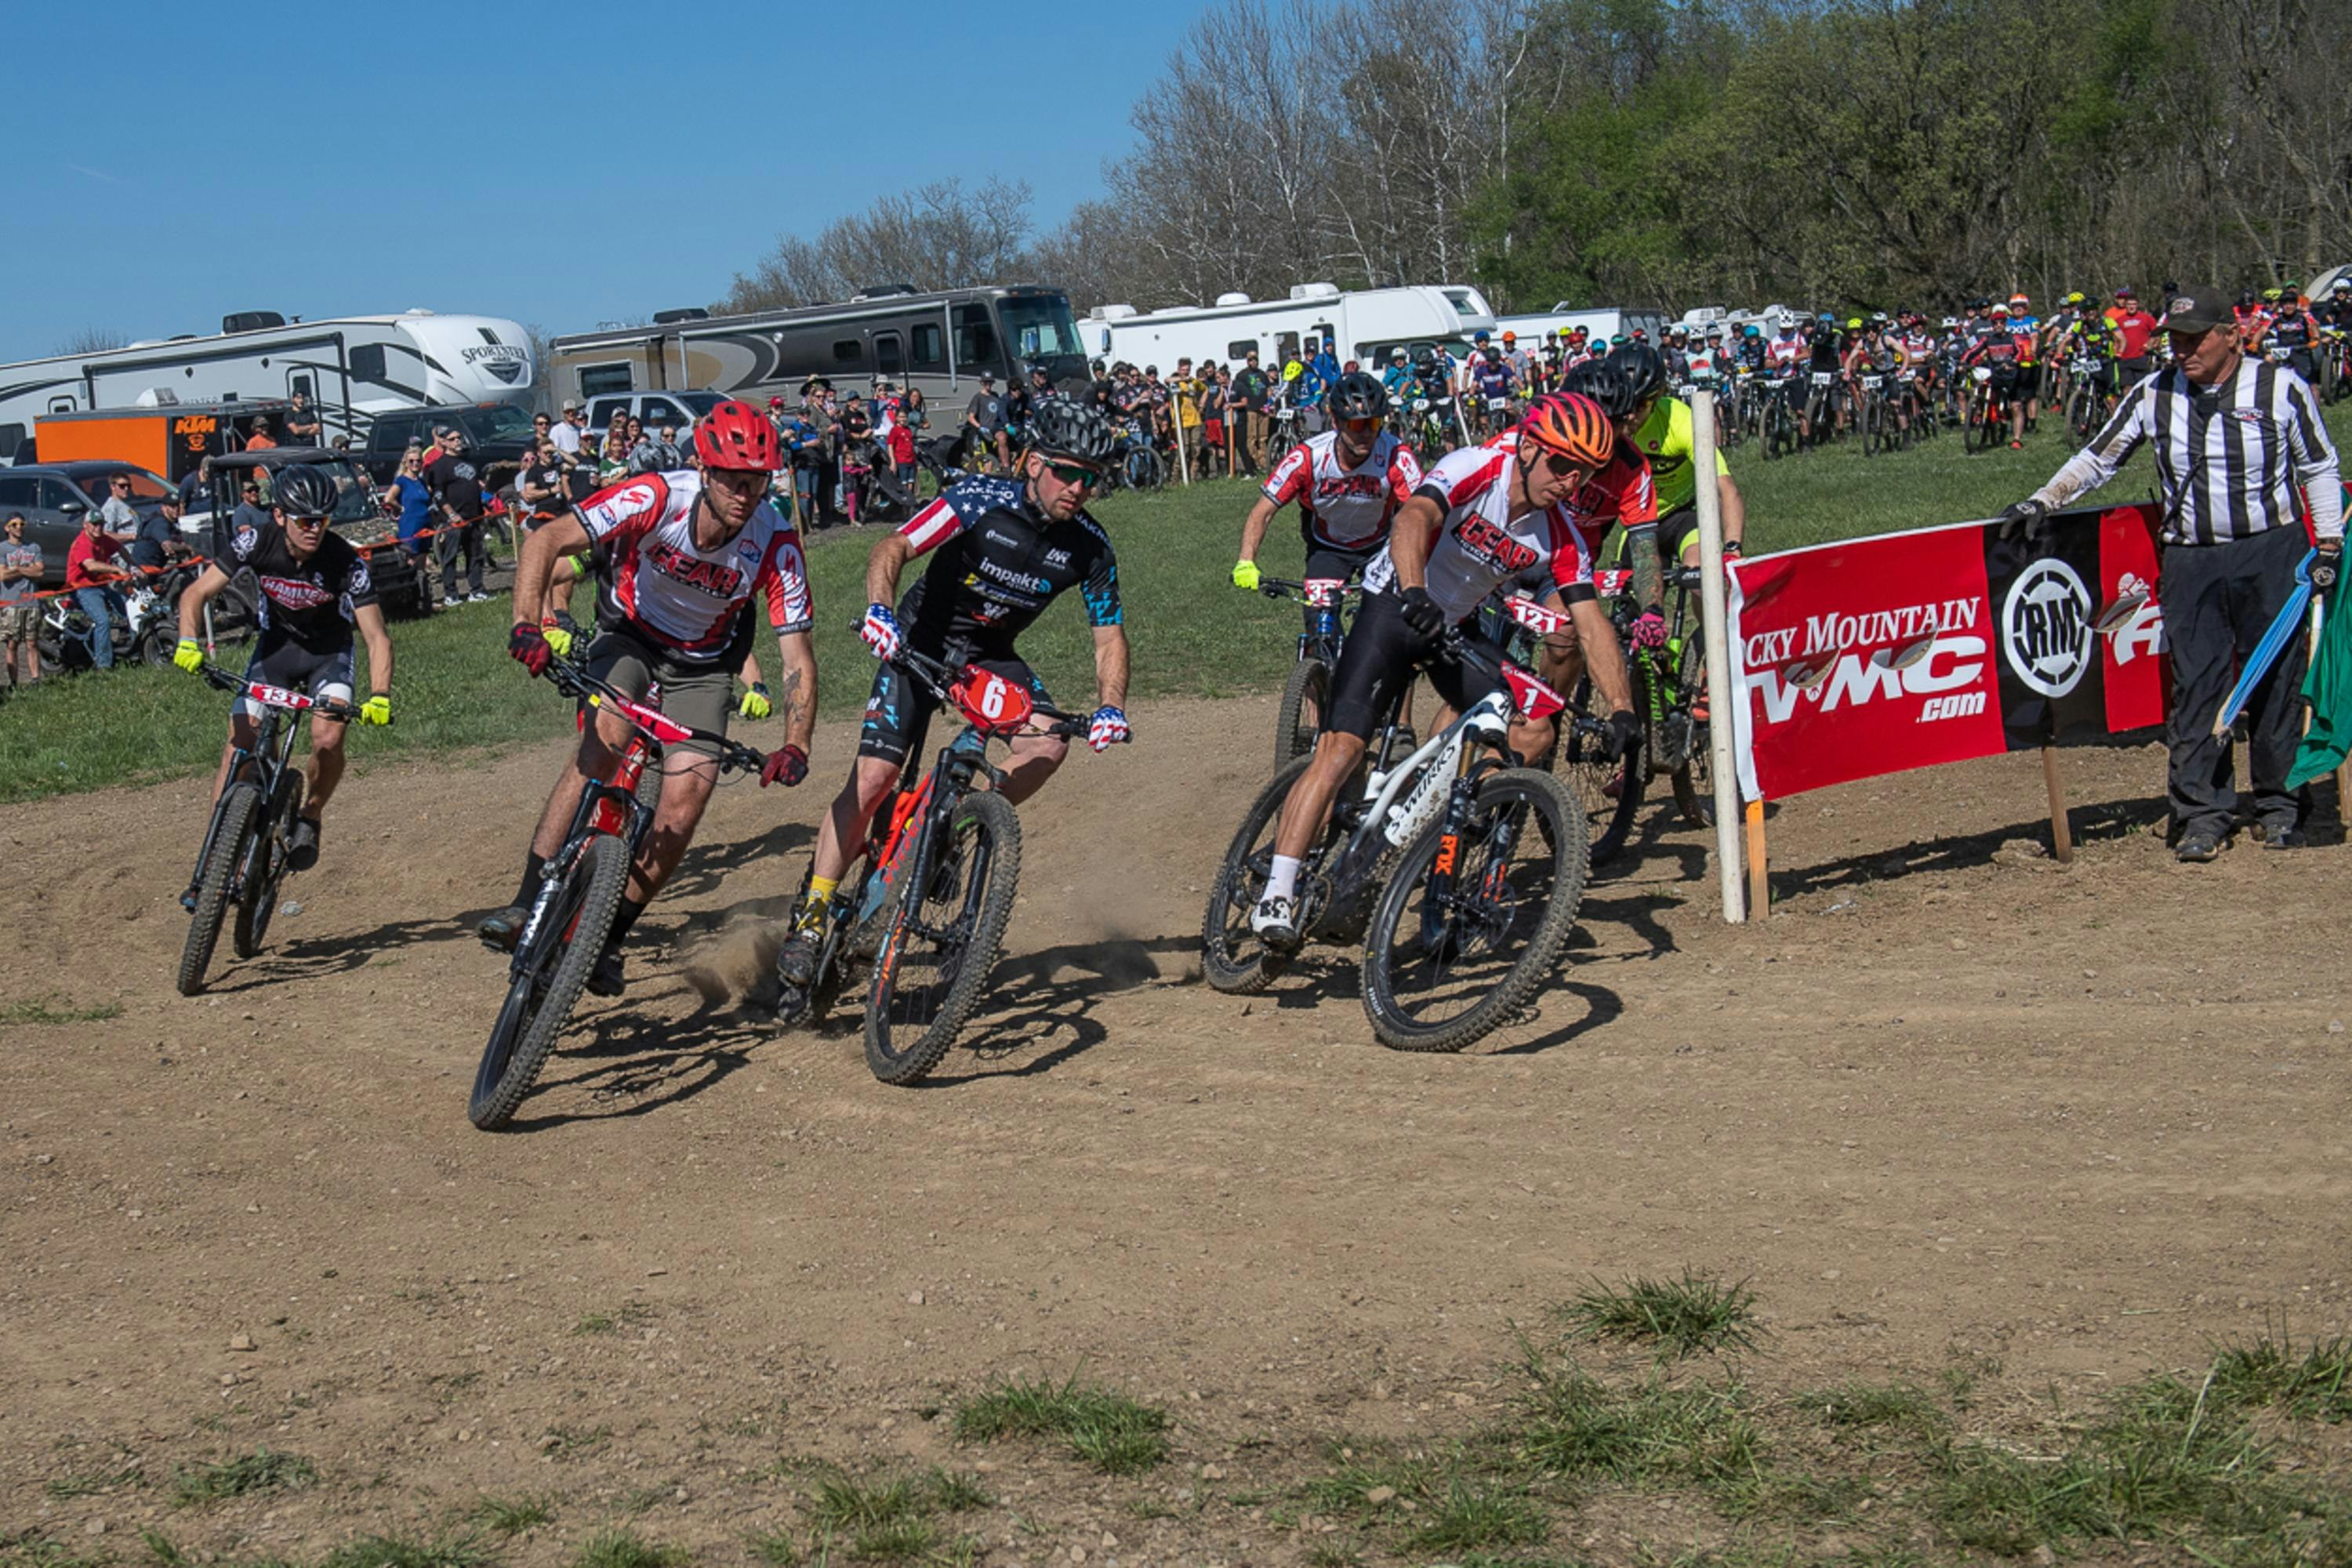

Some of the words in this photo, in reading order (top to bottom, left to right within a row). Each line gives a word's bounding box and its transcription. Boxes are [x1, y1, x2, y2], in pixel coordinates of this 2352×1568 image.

[175, 415, 216, 434] KTM
[1460, 513, 1537, 569] GEAR
[646, 541, 741, 594] GEAR
[979, 556, 1040, 590] impakt
[1514, 605, 1556, 634] 121
[1740, 626, 1798, 667] CKY
[1802, 597, 1982, 656] MOUNTAIN
[982, 680, 1007, 719] 6
[1522, 688, 1539, 715] 1
[1915, 691, 1987, 723] .com
